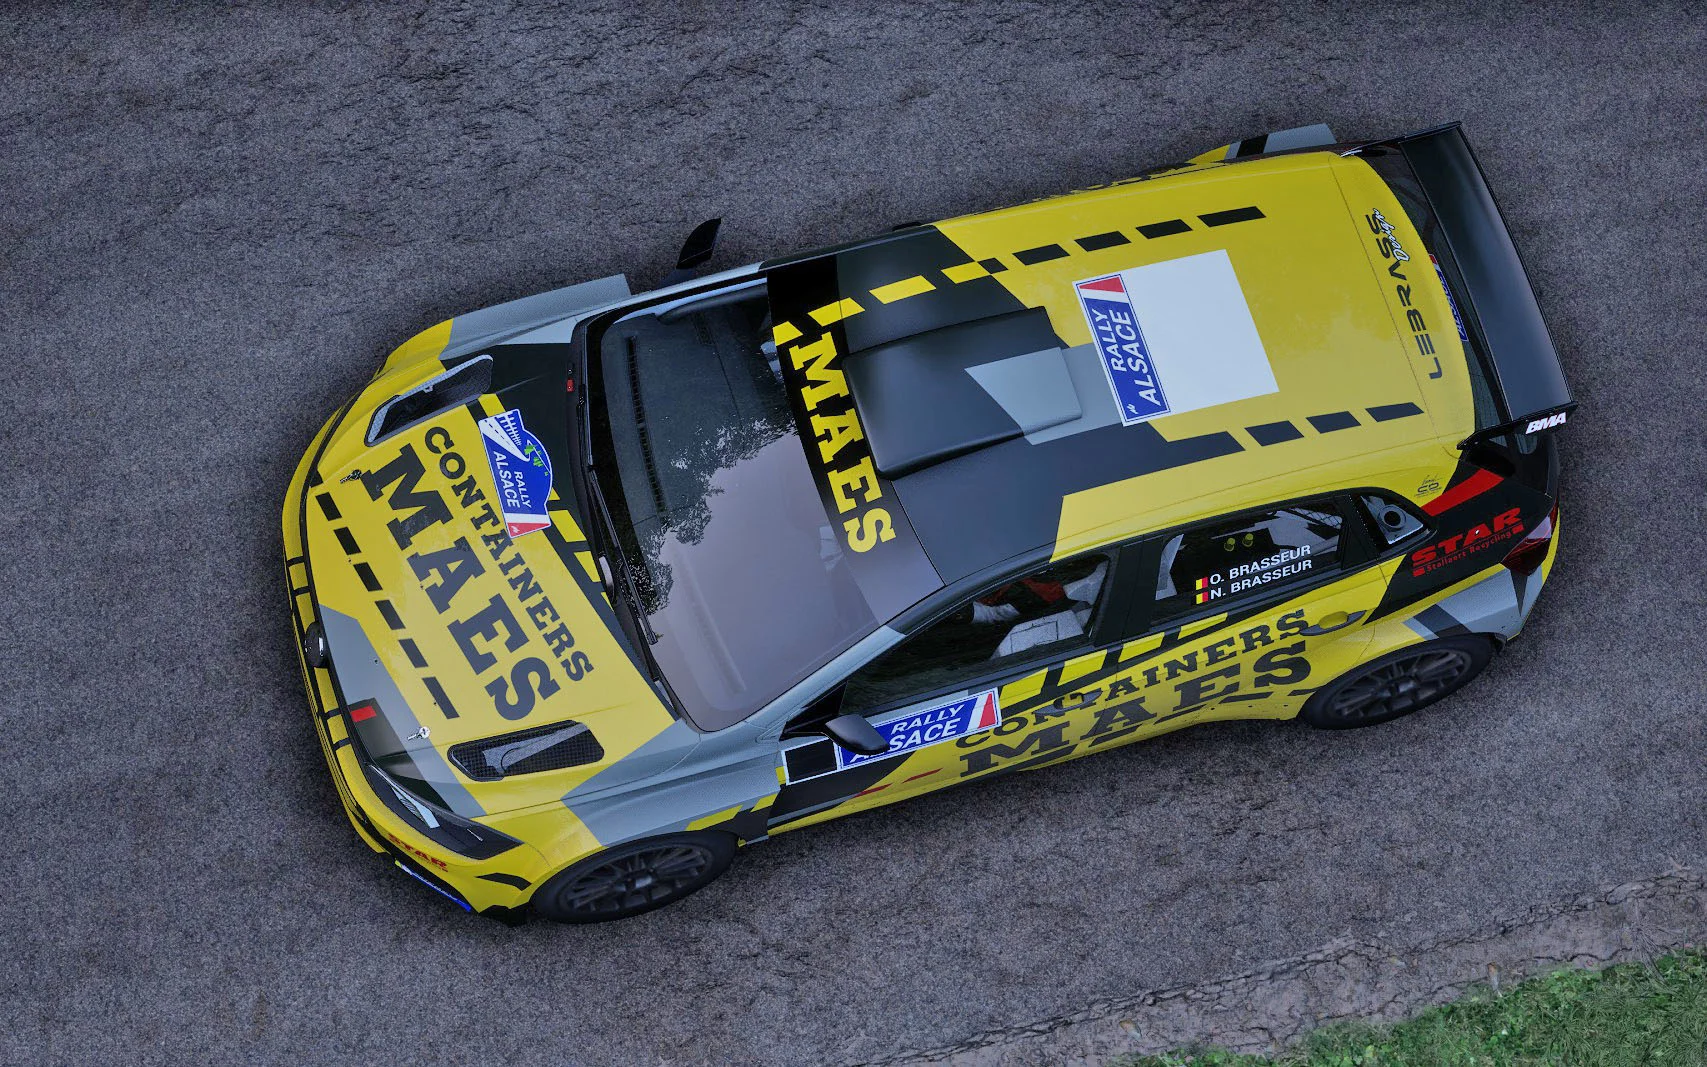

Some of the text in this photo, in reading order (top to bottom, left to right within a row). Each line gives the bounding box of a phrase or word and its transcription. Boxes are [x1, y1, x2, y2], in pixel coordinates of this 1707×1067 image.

[1365, 213, 1443, 380] LEBRASS
[1091, 308, 1127, 372] RALLY
[1109, 309, 1161, 407] ALSACE
[788, 331, 896, 554] MAES
[1525, 411, 1567, 435] BMA
[493, 450, 521, 508] ALSACE
[513, 470, 532, 509] RALLY
[424, 425, 595, 683] CONTAINERS
[1209, 544, 1311, 585] O. BRASSEUR
[1411, 507, 1521, 567] STAR
[359, 443, 560, 721] MAES
[1210, 559, 1313, 600] N. BRASSEUR
[891, 704, 965, 735] RALLY
[959, 640, 1311, 778] MAES
[850, 717, 961, 763] SACE
